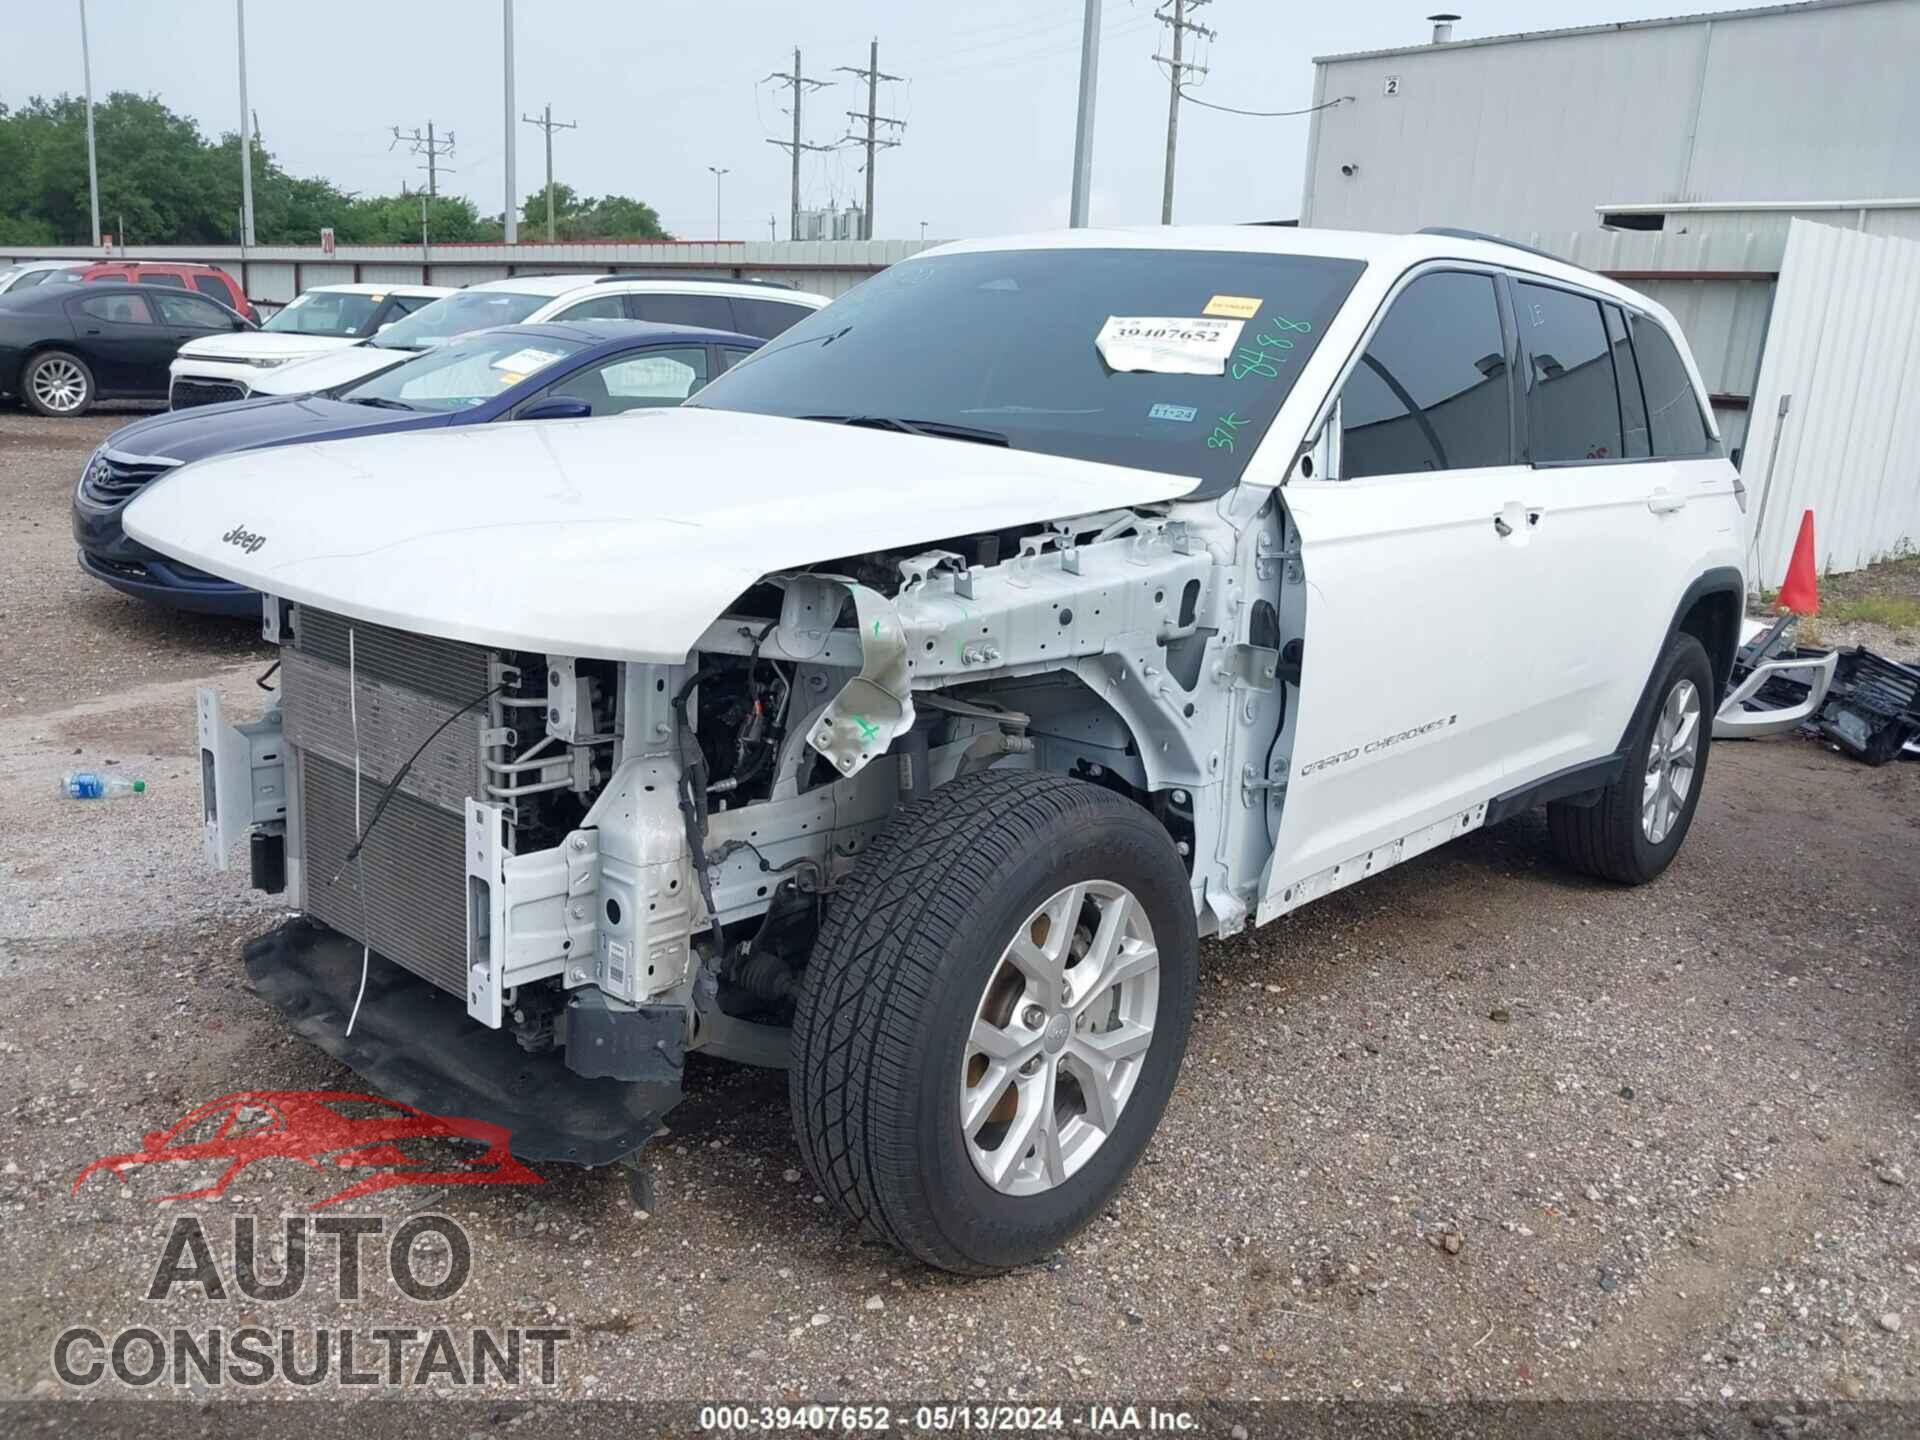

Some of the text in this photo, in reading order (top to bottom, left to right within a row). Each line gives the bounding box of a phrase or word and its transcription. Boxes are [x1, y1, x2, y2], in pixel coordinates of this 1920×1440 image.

[1388, 81, 1397, 94] 2
[222, 523, 267, 555] Jeep
[1301, 747, 1360, 777] GRAND
